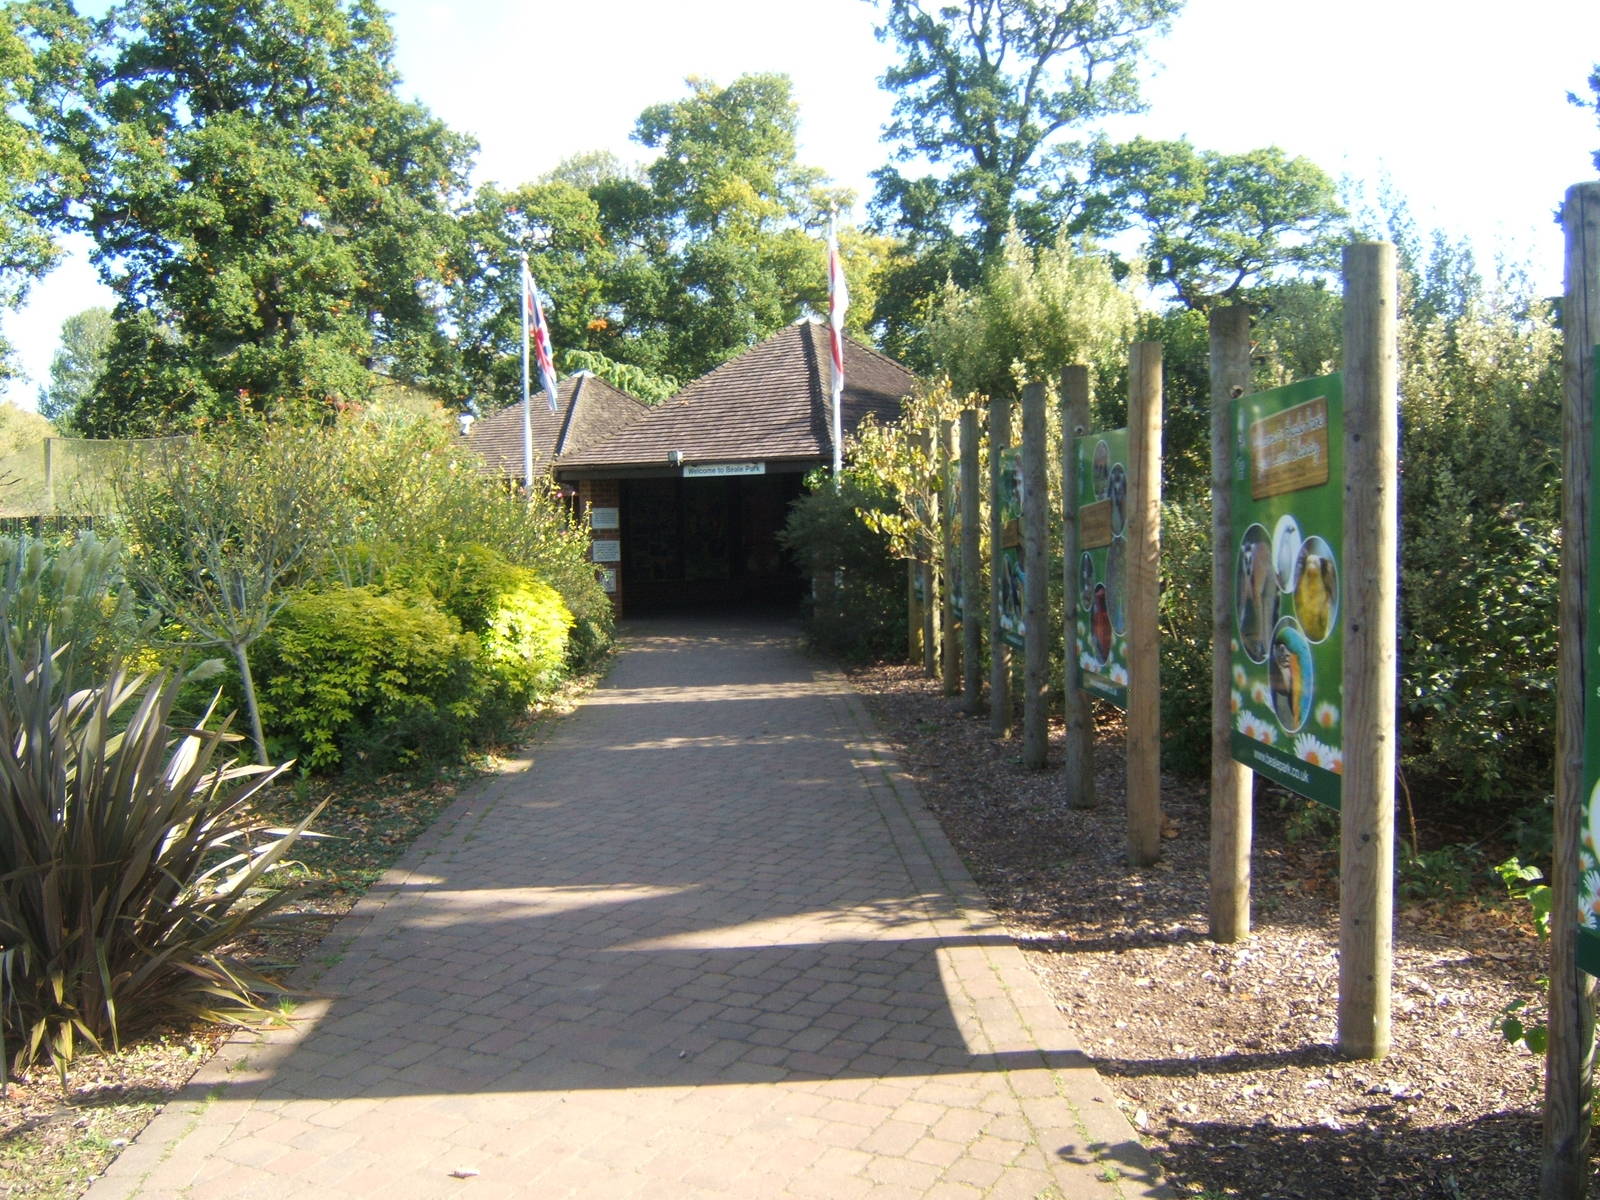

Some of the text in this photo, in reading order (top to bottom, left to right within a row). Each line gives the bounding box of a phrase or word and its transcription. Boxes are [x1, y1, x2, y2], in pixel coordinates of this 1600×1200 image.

[688, 464, 761, 475] Welcome to Beale Park
